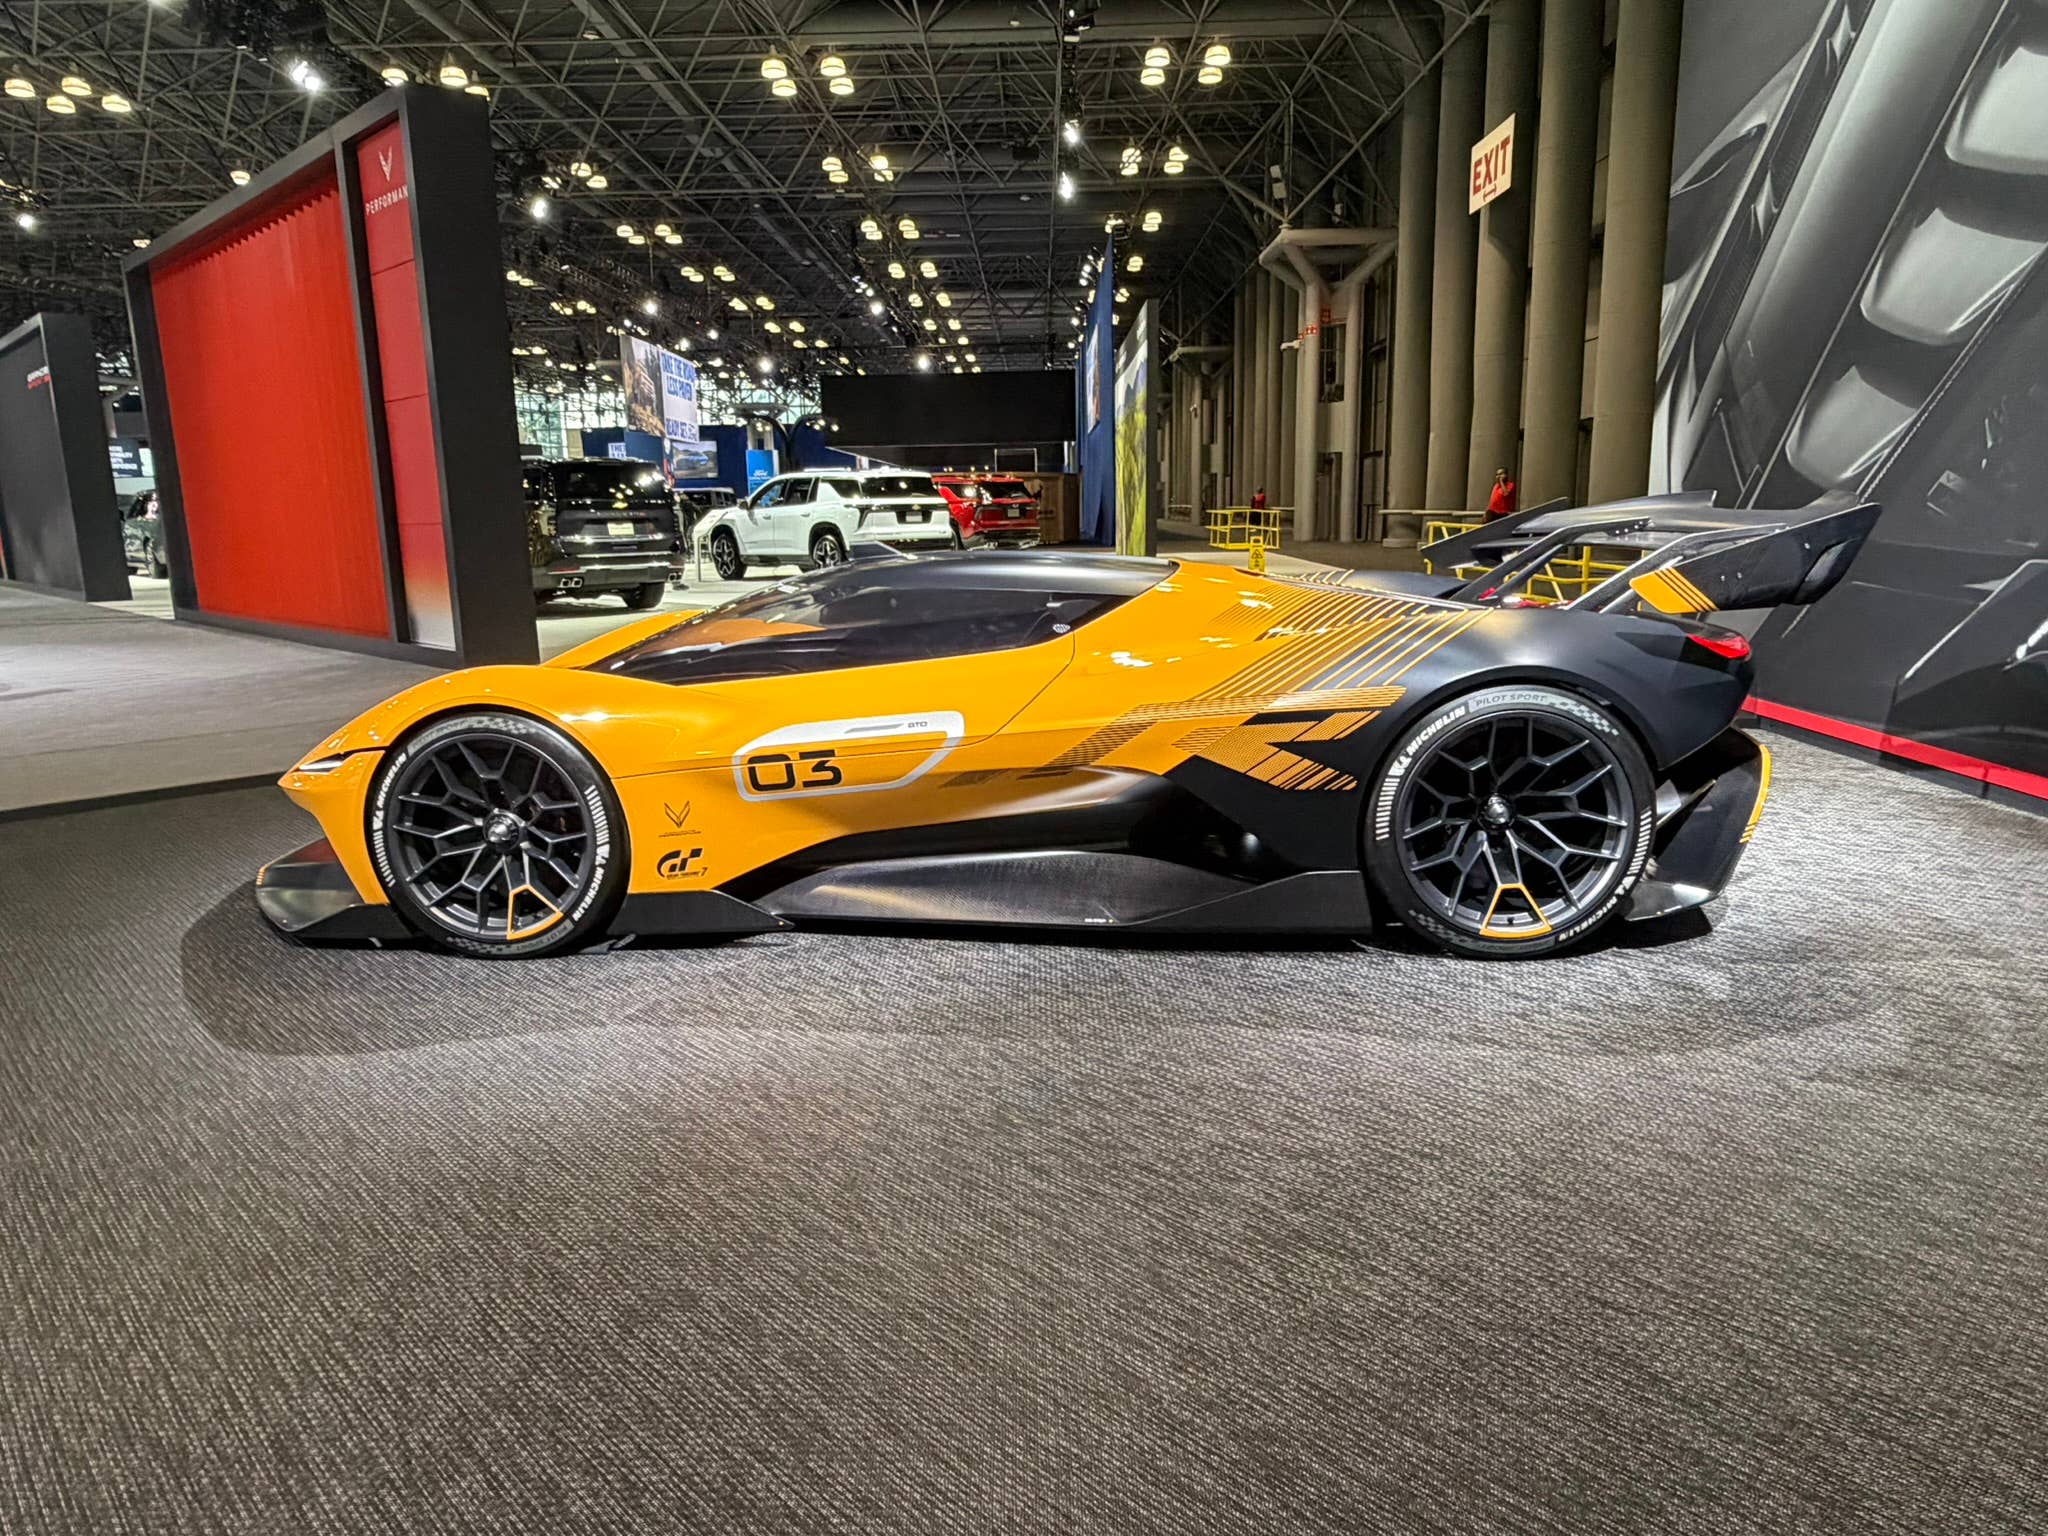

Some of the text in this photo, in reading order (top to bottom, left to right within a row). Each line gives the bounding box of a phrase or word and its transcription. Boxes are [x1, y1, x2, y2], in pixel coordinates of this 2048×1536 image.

[1473, 134, 1511, 197] EXIT
[1475, 693, 1549, 708] PILOT SPORT
[1405, 705, 1467, 757] MICHELIN
[376, 752, 407, 809] MICHELIN
[747, 749, 843, 792] 03
[571, 865, 605, 923] MICHELIN
[1558, 896, 1618, 942] MICHELIN
